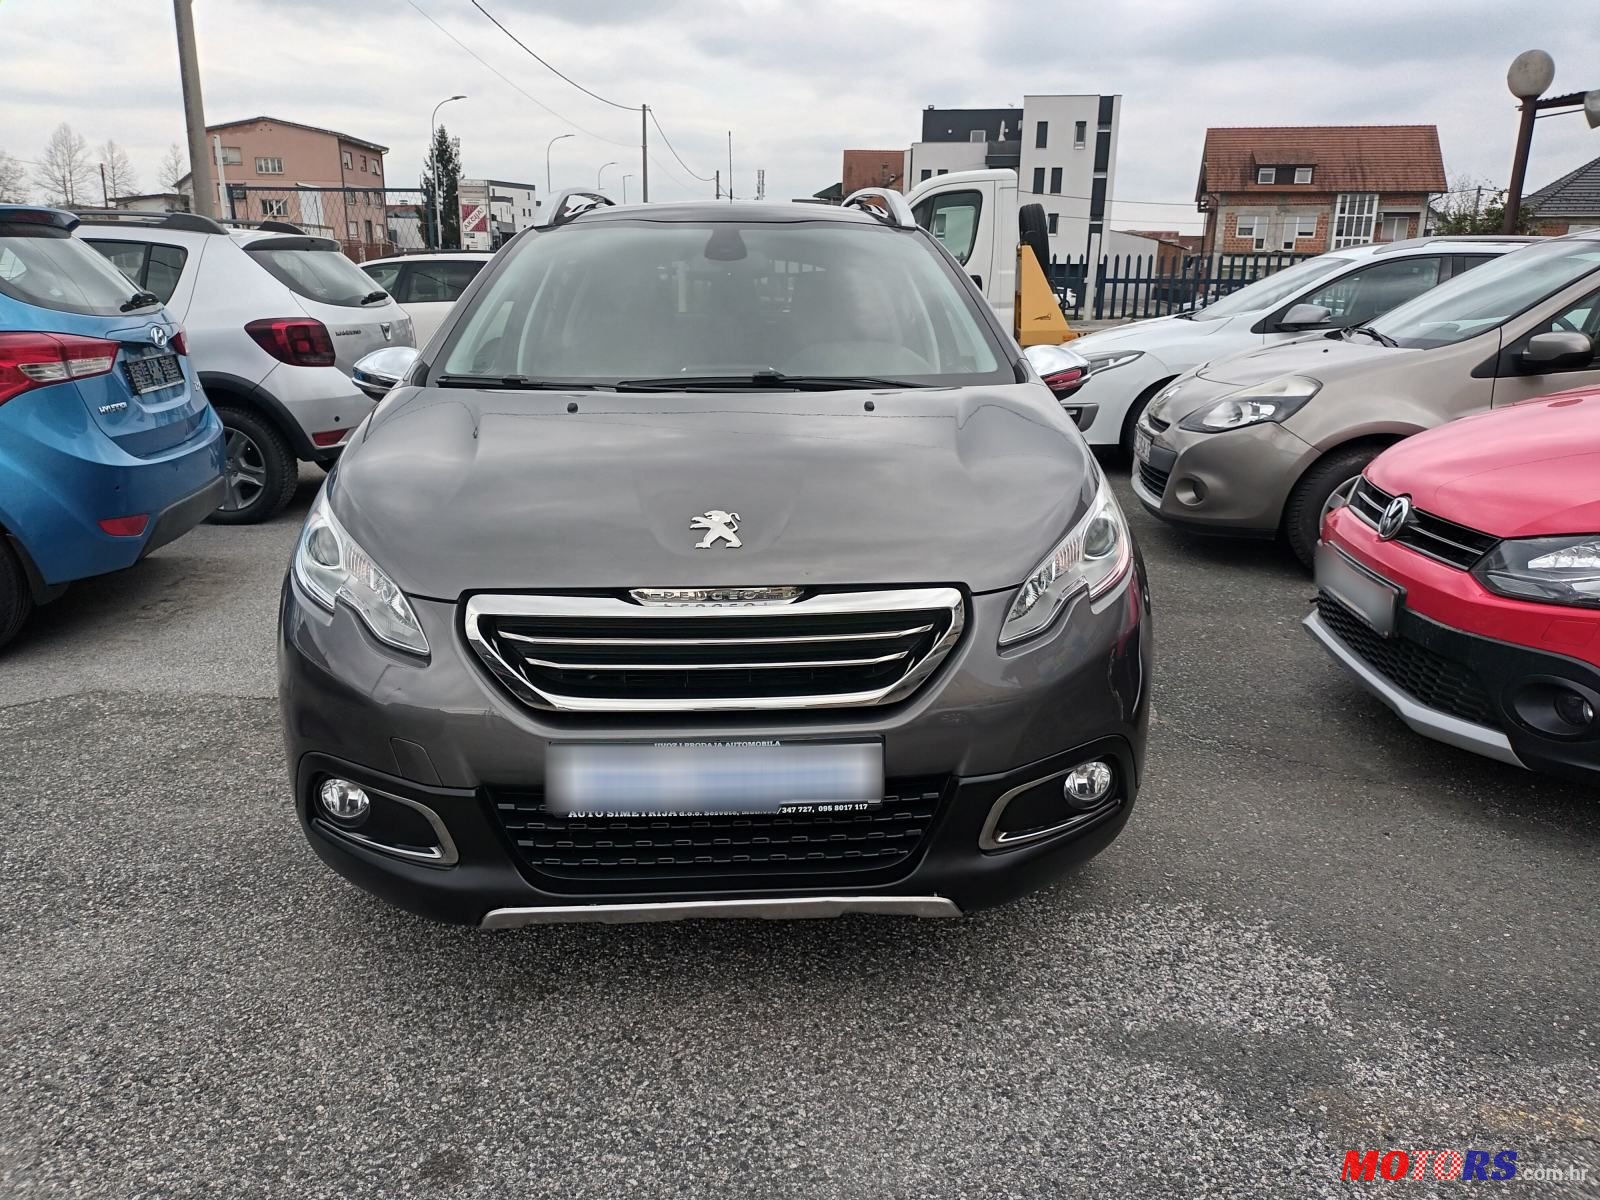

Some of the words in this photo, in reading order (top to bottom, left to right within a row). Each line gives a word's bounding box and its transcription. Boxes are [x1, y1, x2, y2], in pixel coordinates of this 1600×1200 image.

[725, 740, 781, 748] AUTOMOBILA
[567, 809, 604, 818] AUTO
[834, 803, 853, 811] 8017
[855, 803, 868, 811] 117
